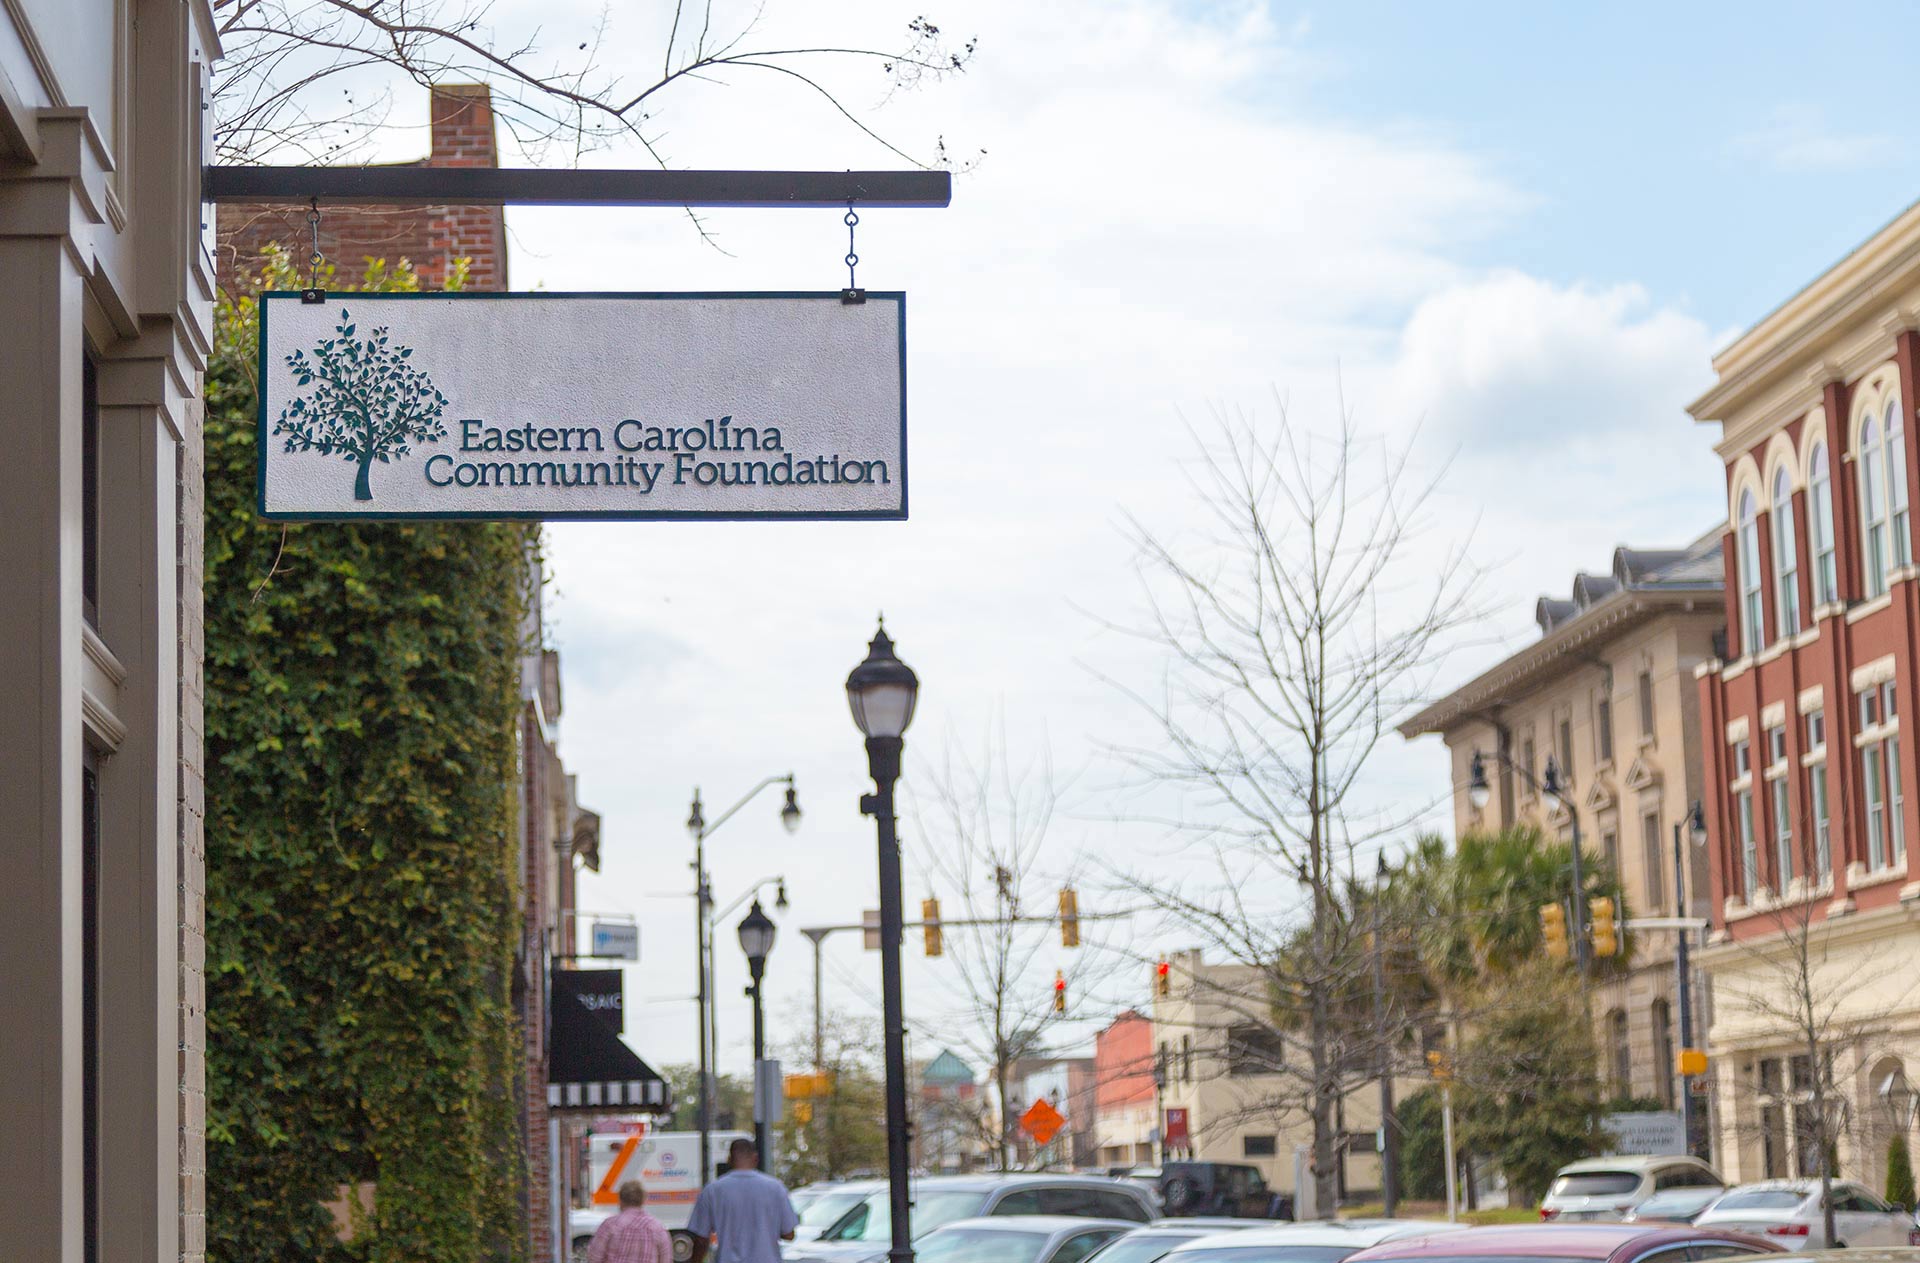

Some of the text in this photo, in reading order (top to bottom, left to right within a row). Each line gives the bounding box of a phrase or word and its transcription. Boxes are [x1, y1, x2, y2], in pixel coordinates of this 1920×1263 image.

[459, 416, 784, 451] Eastern Carolina
[425, 453, 891, 494] Community Foundation
